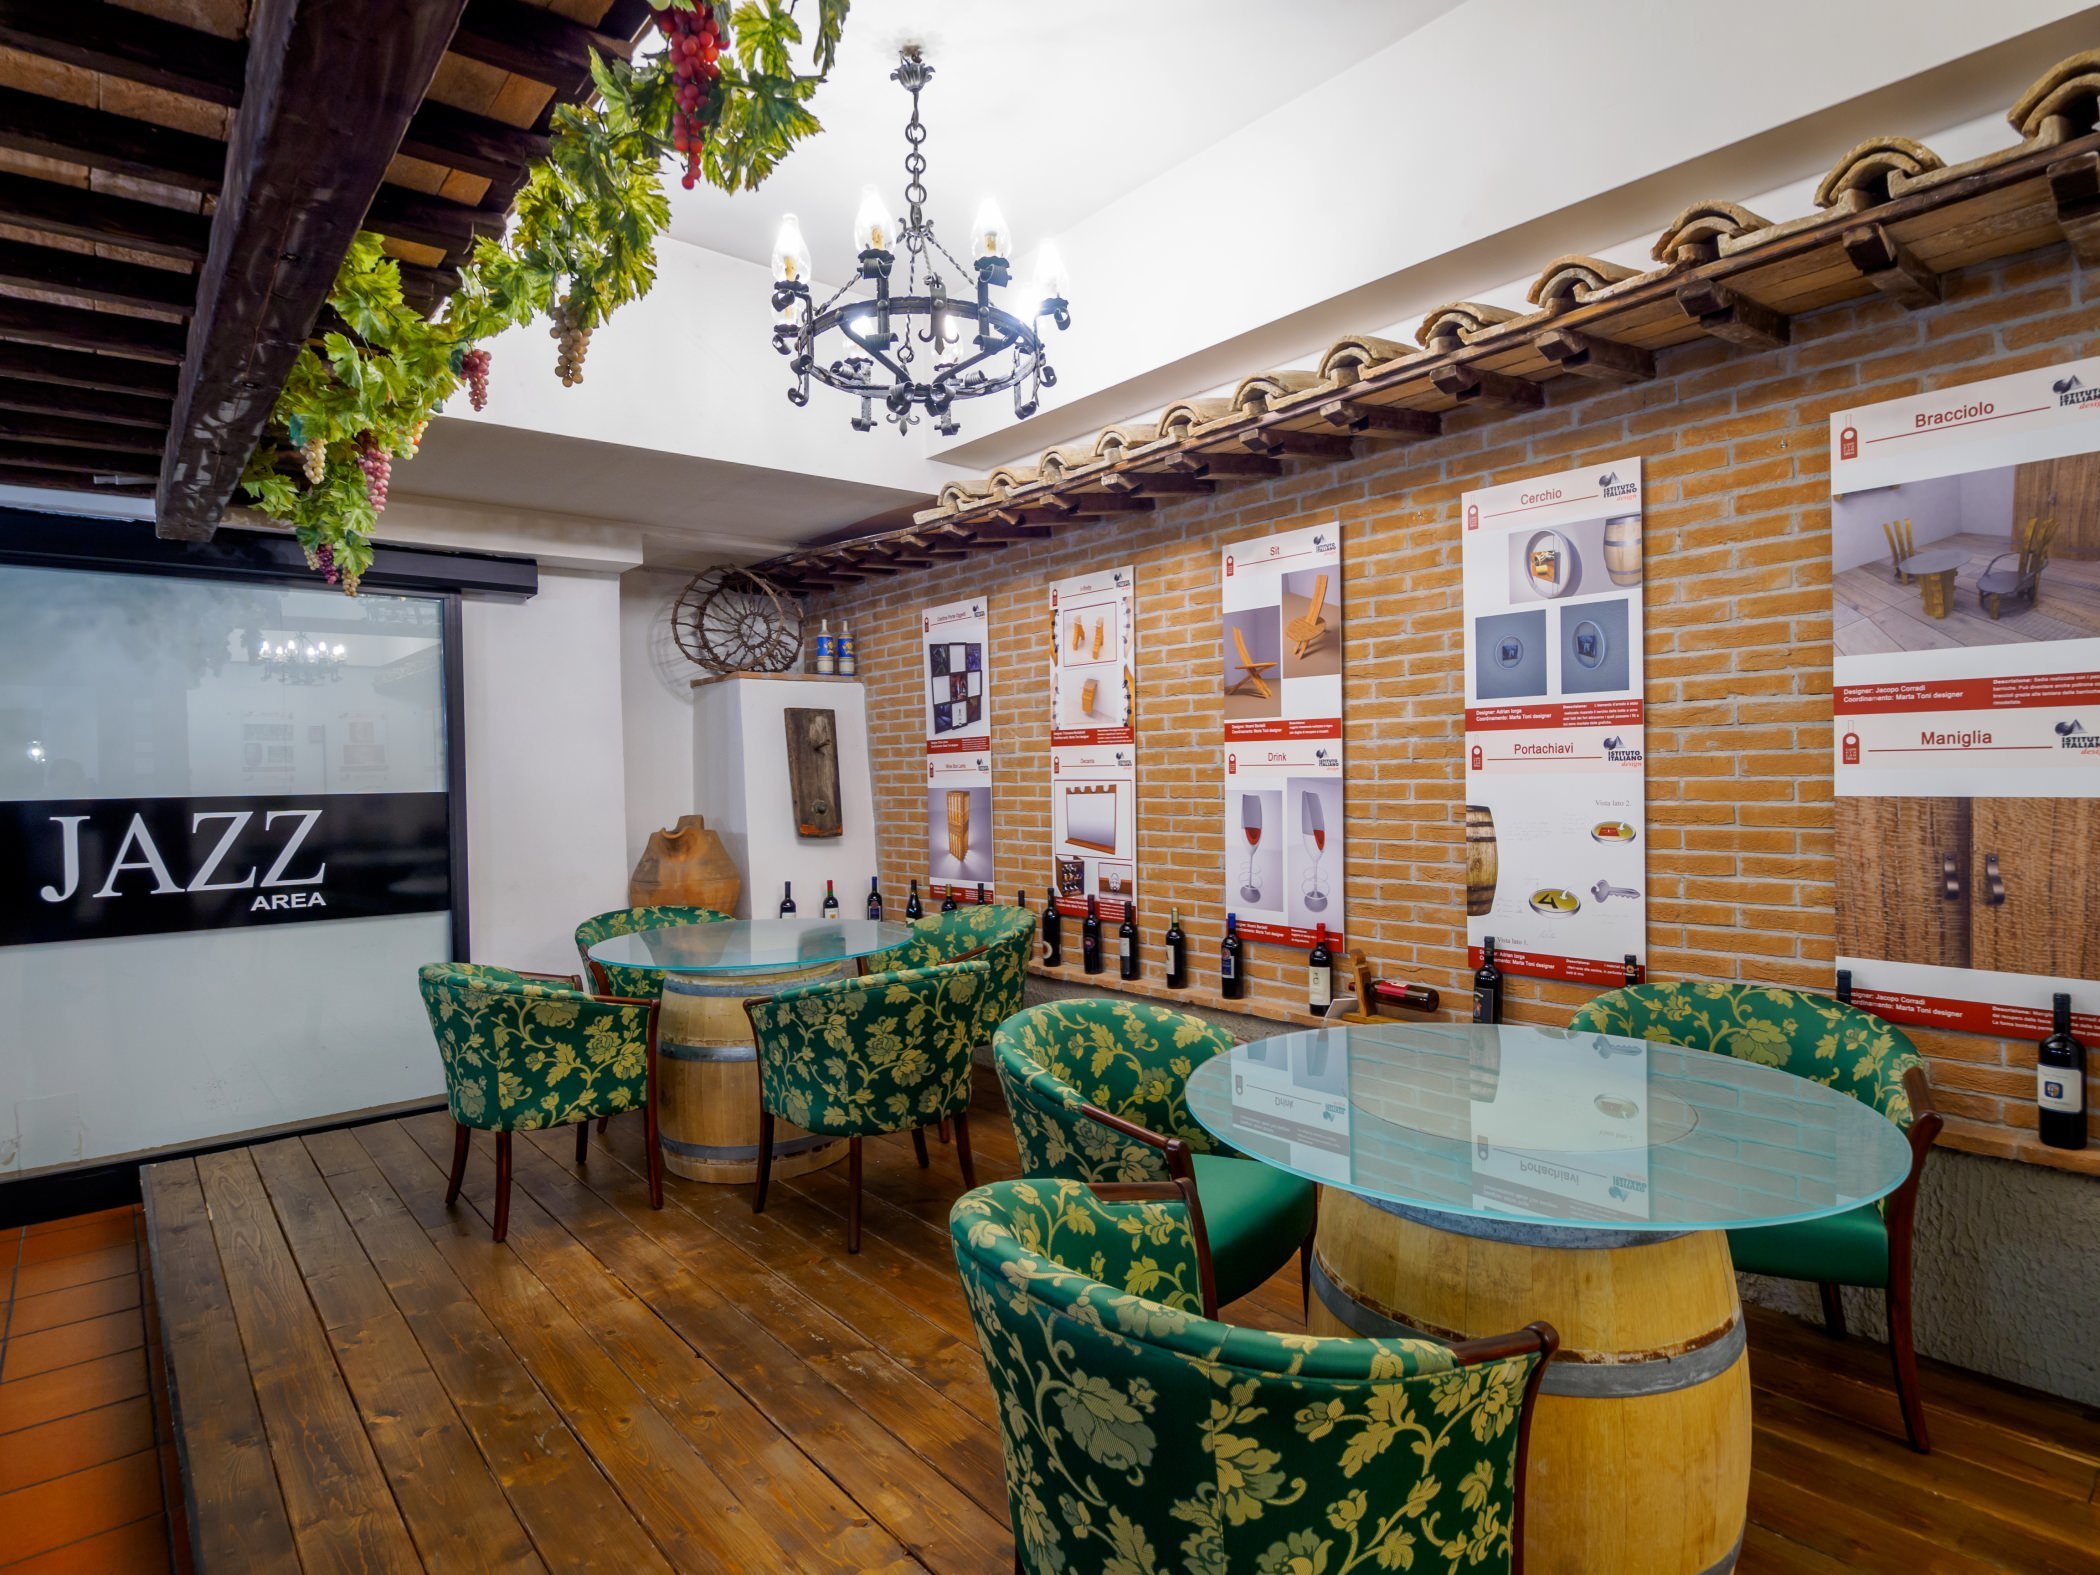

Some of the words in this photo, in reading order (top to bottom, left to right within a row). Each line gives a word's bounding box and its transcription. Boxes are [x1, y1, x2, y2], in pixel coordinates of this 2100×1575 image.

[2060, 388, 2100, 401] ISTITUT
[2060, 394, 2100, 407] ITALIAN
[1915, 401, 1995, 428] Bracciolo
[1603, 482, 1636, 493] ISTITUTO
[1603, 487, 1638, 498] ITALIANO
[1520, 488, 1562, 506] Cerchio
[1875, 686, 1899, 694] Jacopo
[1843, 694, 1894, 703] Coordinamento:
[1895, 693, 1915, 701] Marta
[1933, 691, 1964, 699] designer
[1920, 730, 1993, 747] Maniglia
[1513, 742, 1574, 755] Portachiavi
[1267, 752, 1287, 762] Drink
[40, 809, 326, 902] JAZZ
[250, 891, 327, 911] AREA
[1875, 993, 1900, 1002] Jacopo
[1900, 996, 1926, 1005] Corradi
[1916, 1006, 1932, 1014] Toni
[1932, 1008, 1964, 1018] designer
